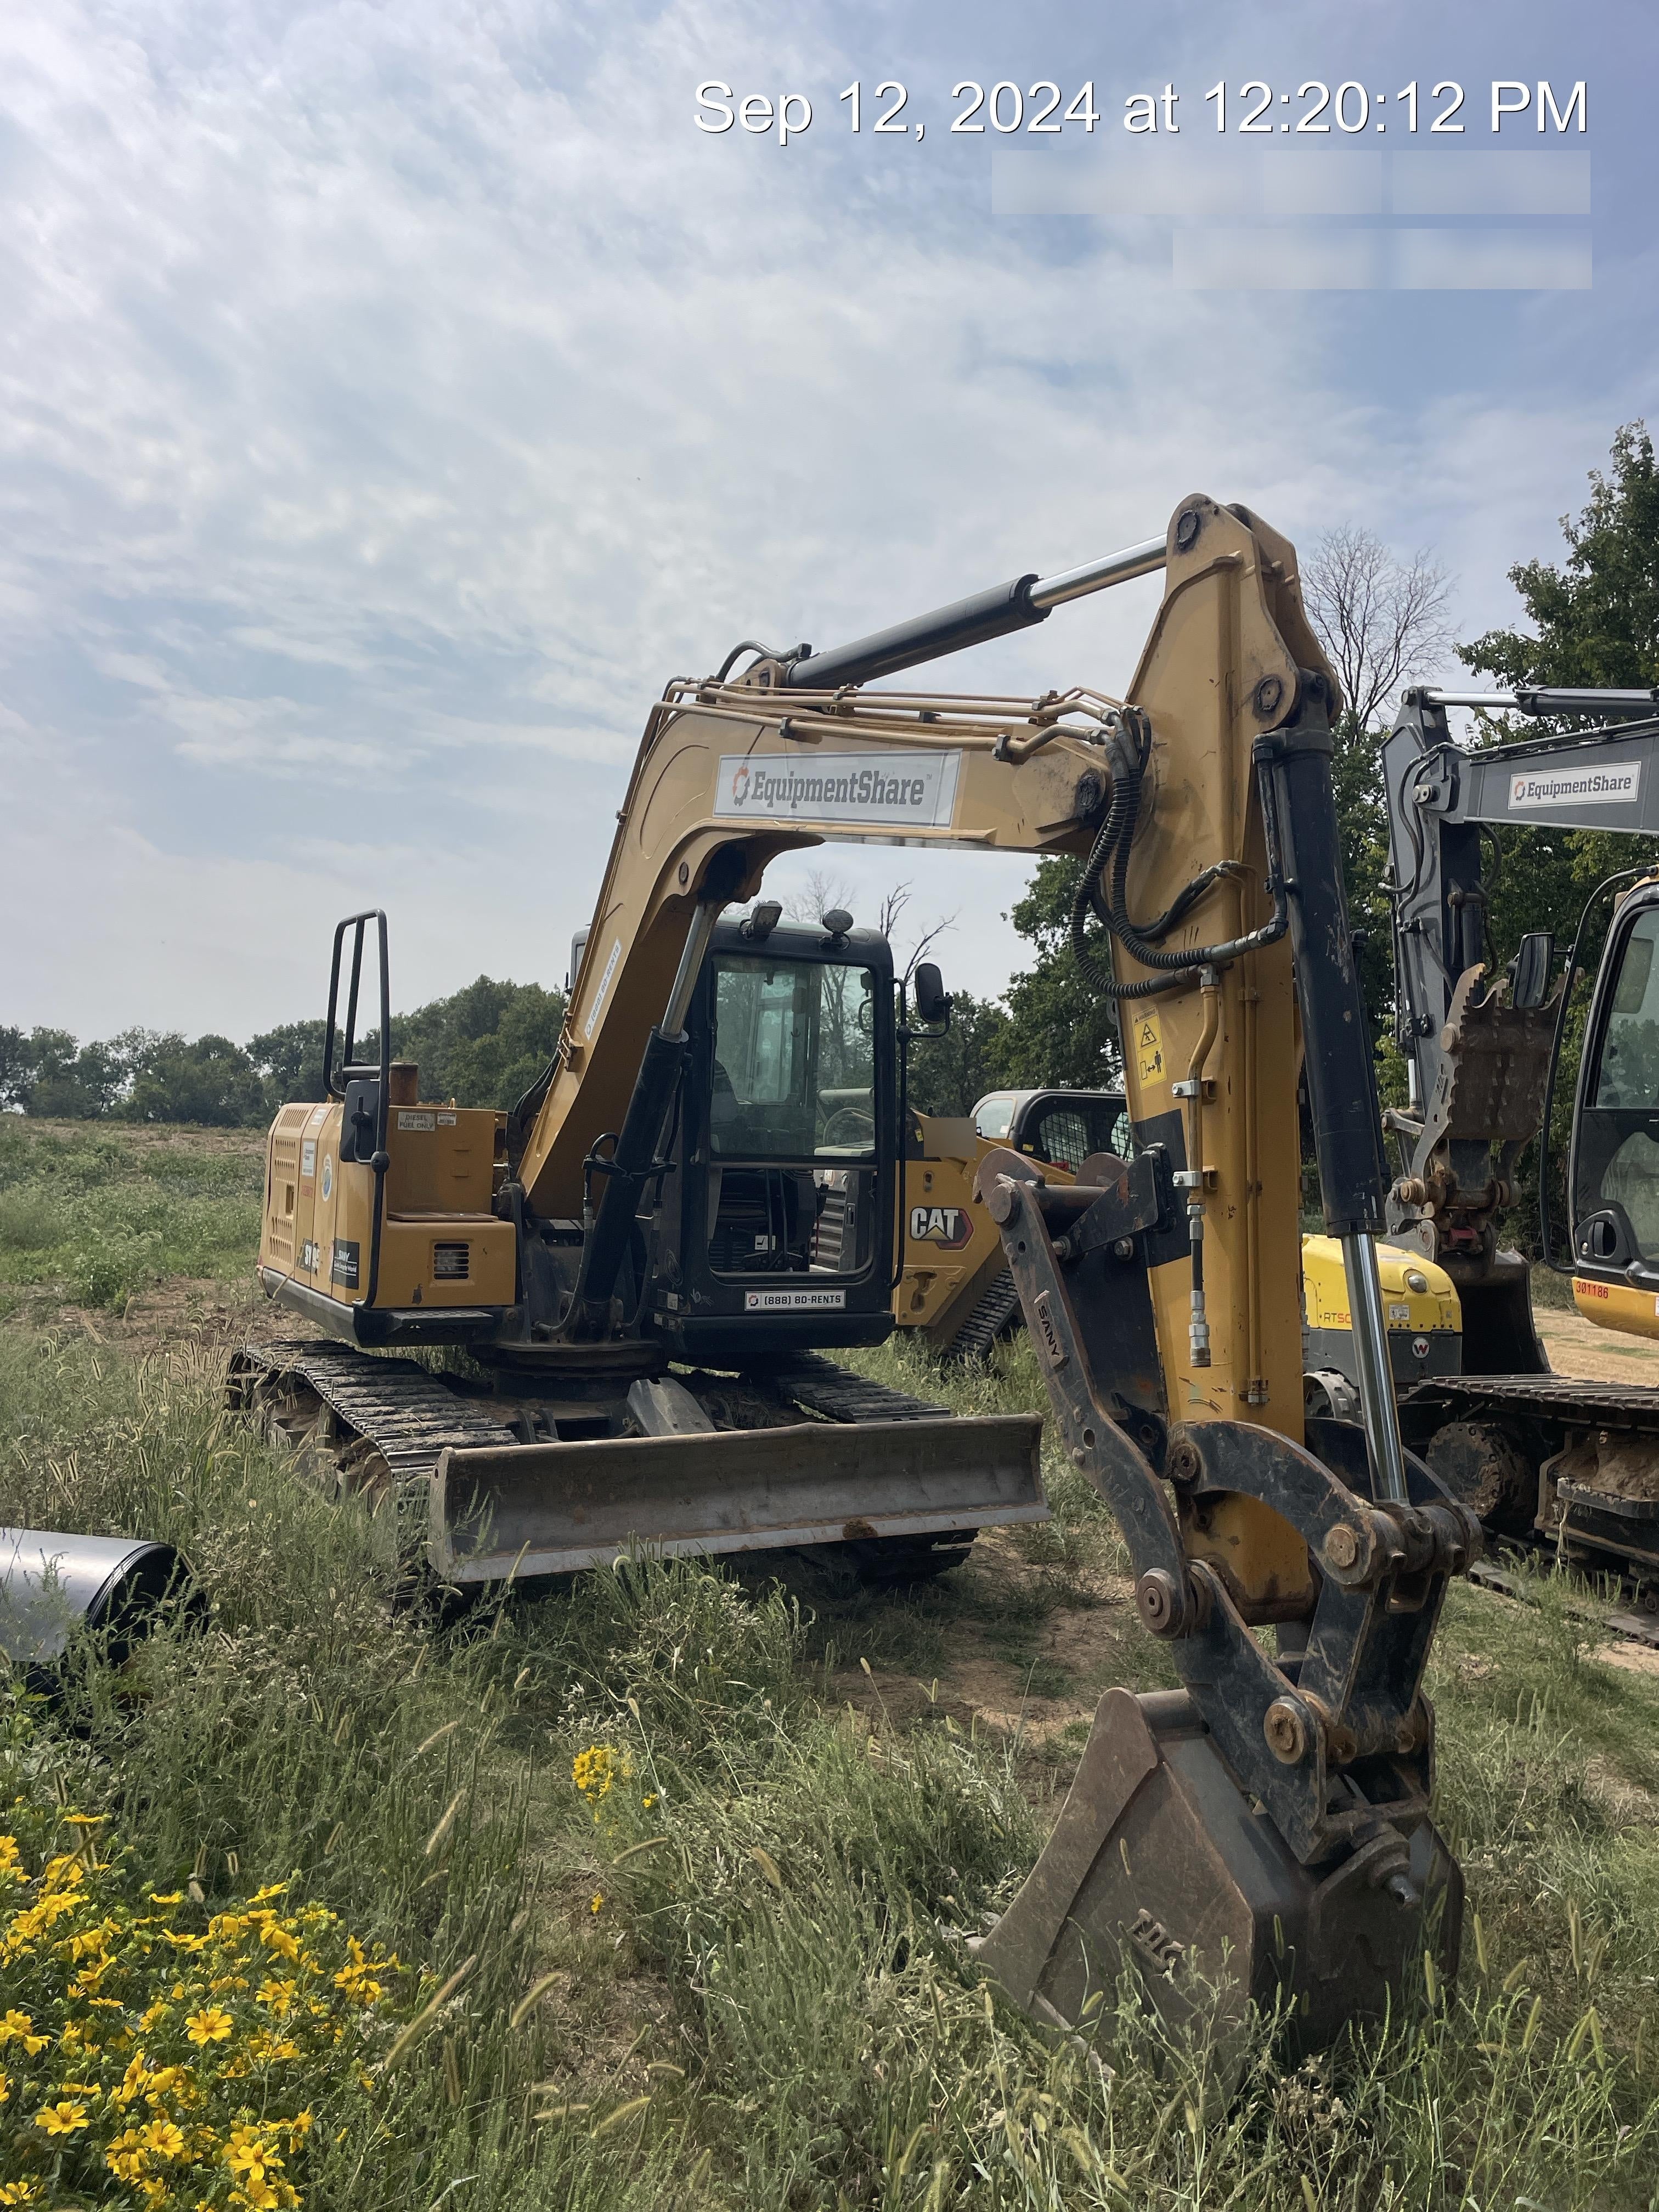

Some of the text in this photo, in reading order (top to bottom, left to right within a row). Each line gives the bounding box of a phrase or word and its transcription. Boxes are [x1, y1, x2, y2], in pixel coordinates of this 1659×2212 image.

[751, 770, 924, 809] EquipmentShare
[1527, 775, 1632, 800] EquipmentShare
[911, 1207, 959, 1240] CAT
[764, 1295, 841, 1305] (888) 80-RENTS
[1576, 1281, 1609, 1299] 301186
[1038, 1305, 1060, 1356] SANY
